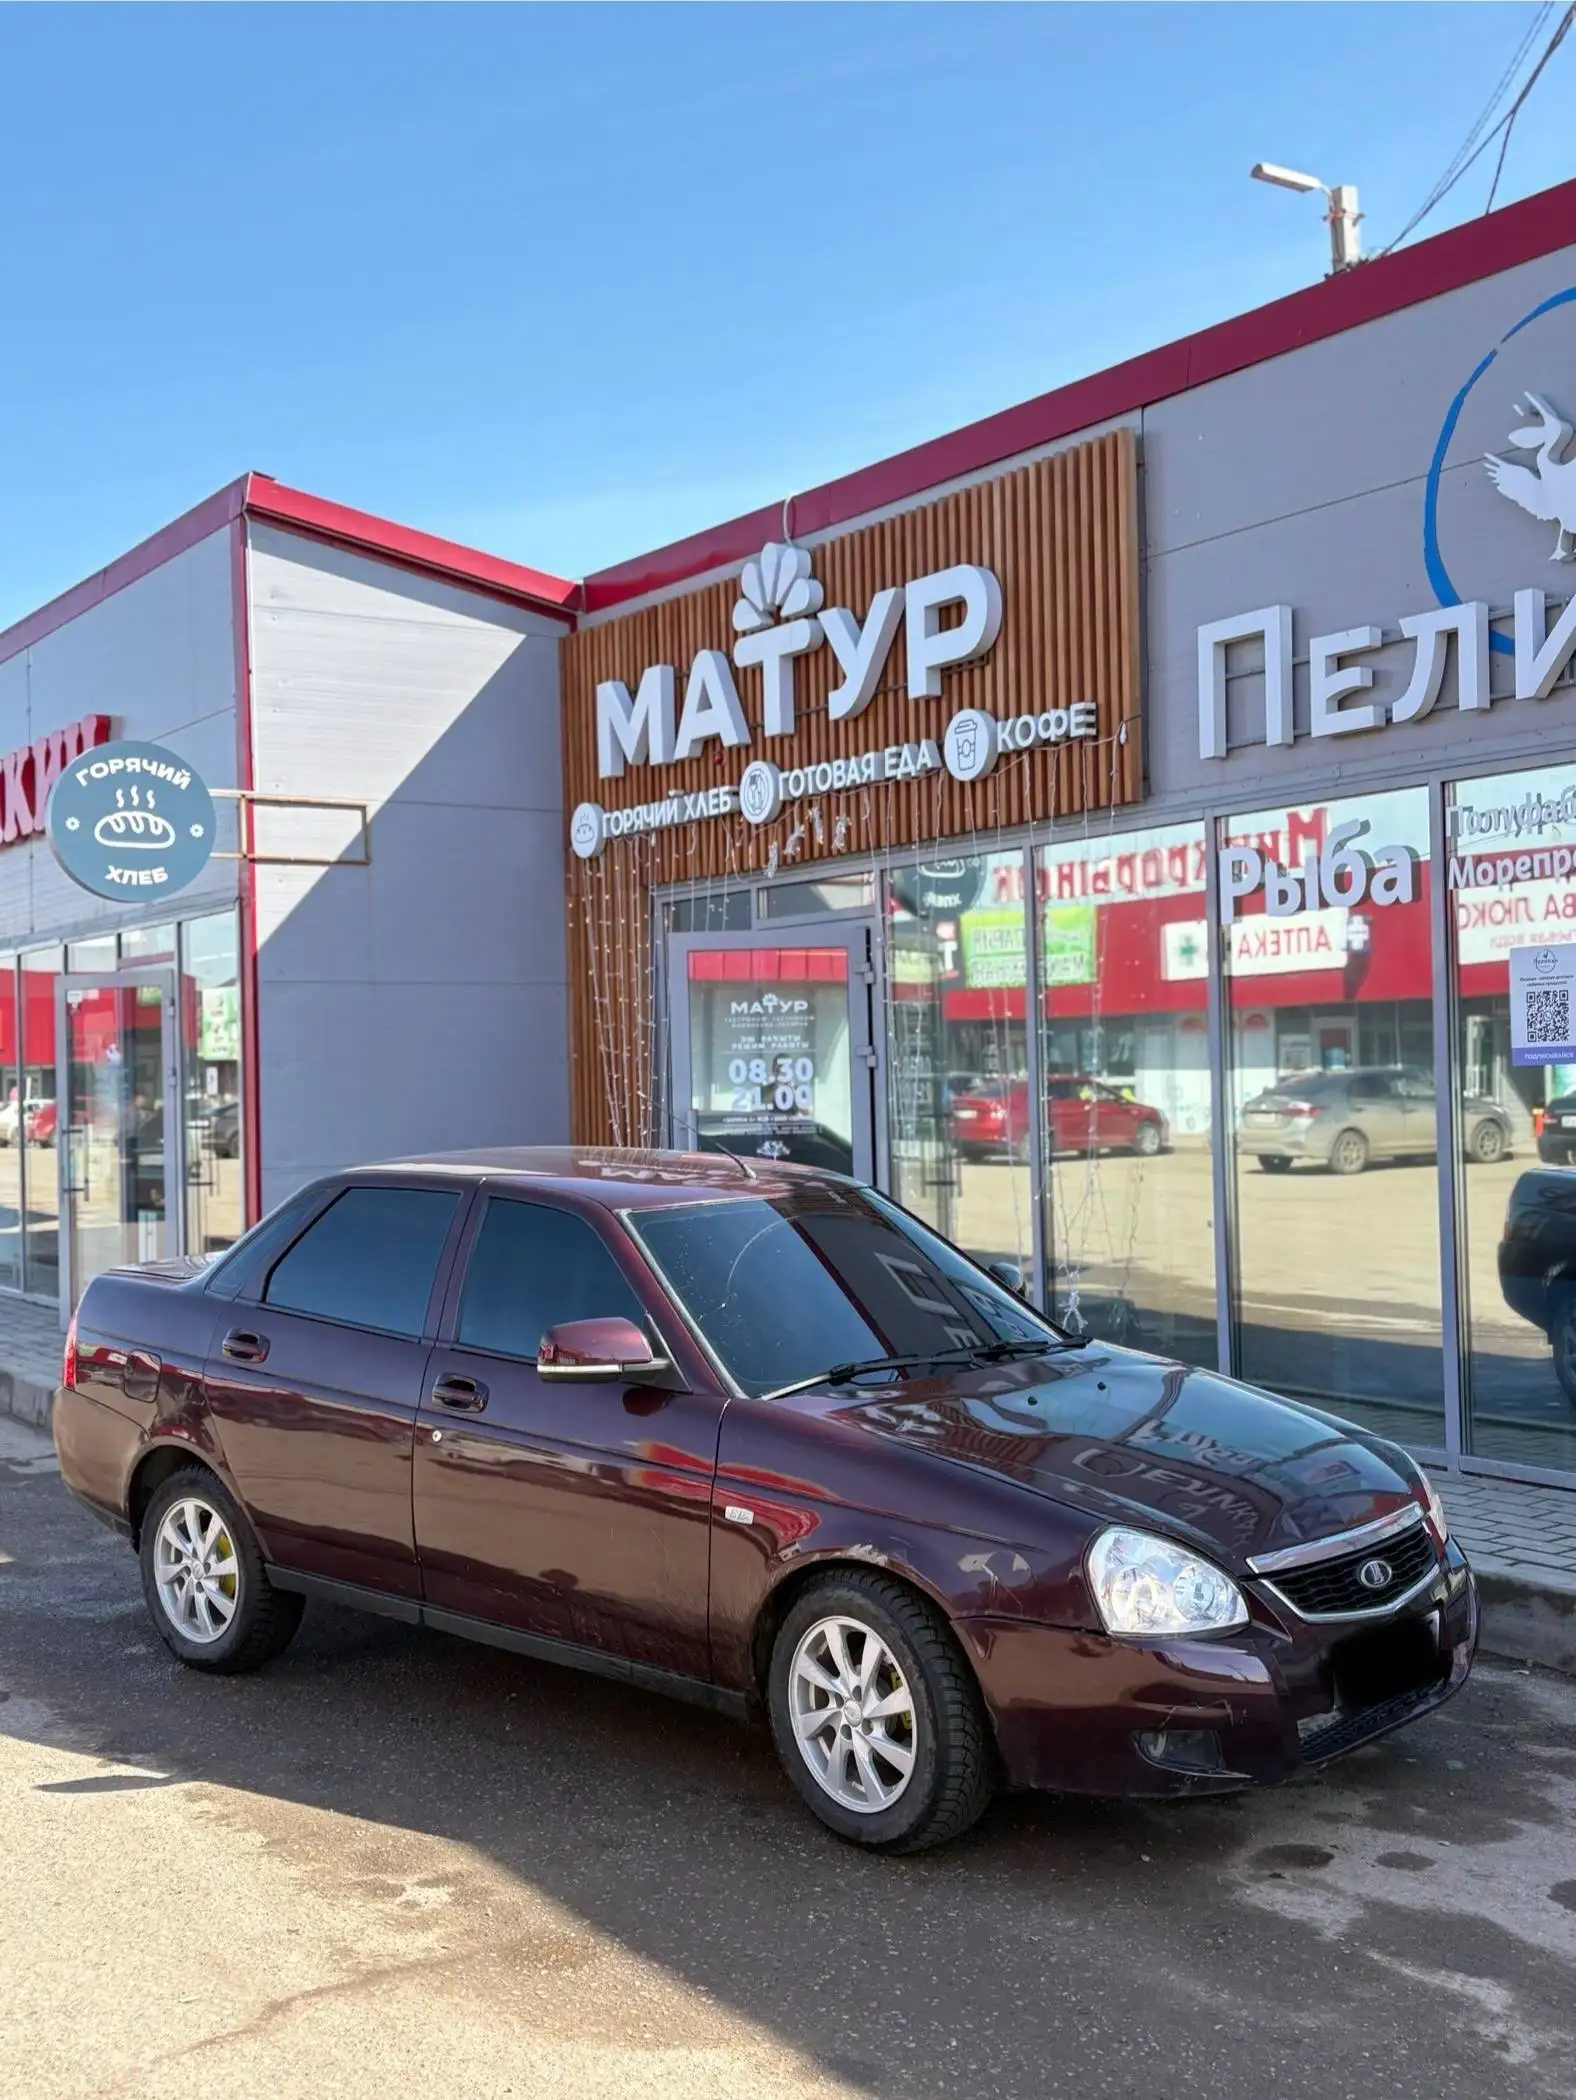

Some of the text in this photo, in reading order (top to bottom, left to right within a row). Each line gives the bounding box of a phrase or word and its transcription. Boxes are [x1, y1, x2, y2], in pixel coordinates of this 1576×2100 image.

[596, 562, 1003, 779] МАТУР
[996, 702, 1097, 752] КОФЕ
[75, 756, 193, 789] ГОРЯЧИЙ
[778, 740, 936, 801] ГОТОВАЯ ЕДА
[602, 785, 732, 838] ГОРЯЧИЙ ХЛЕБ
[104, 864, 170, 886] ХЛЕБ
[1218, 818, 1415, 924] Рыба
[1448, 849, 1576, 892] Морепр
[730, 1000, 809, 1014] МАТУР
[728, 1056, 814, 1085] 08.30
[731, 1086, 813, 1112] 21.00
